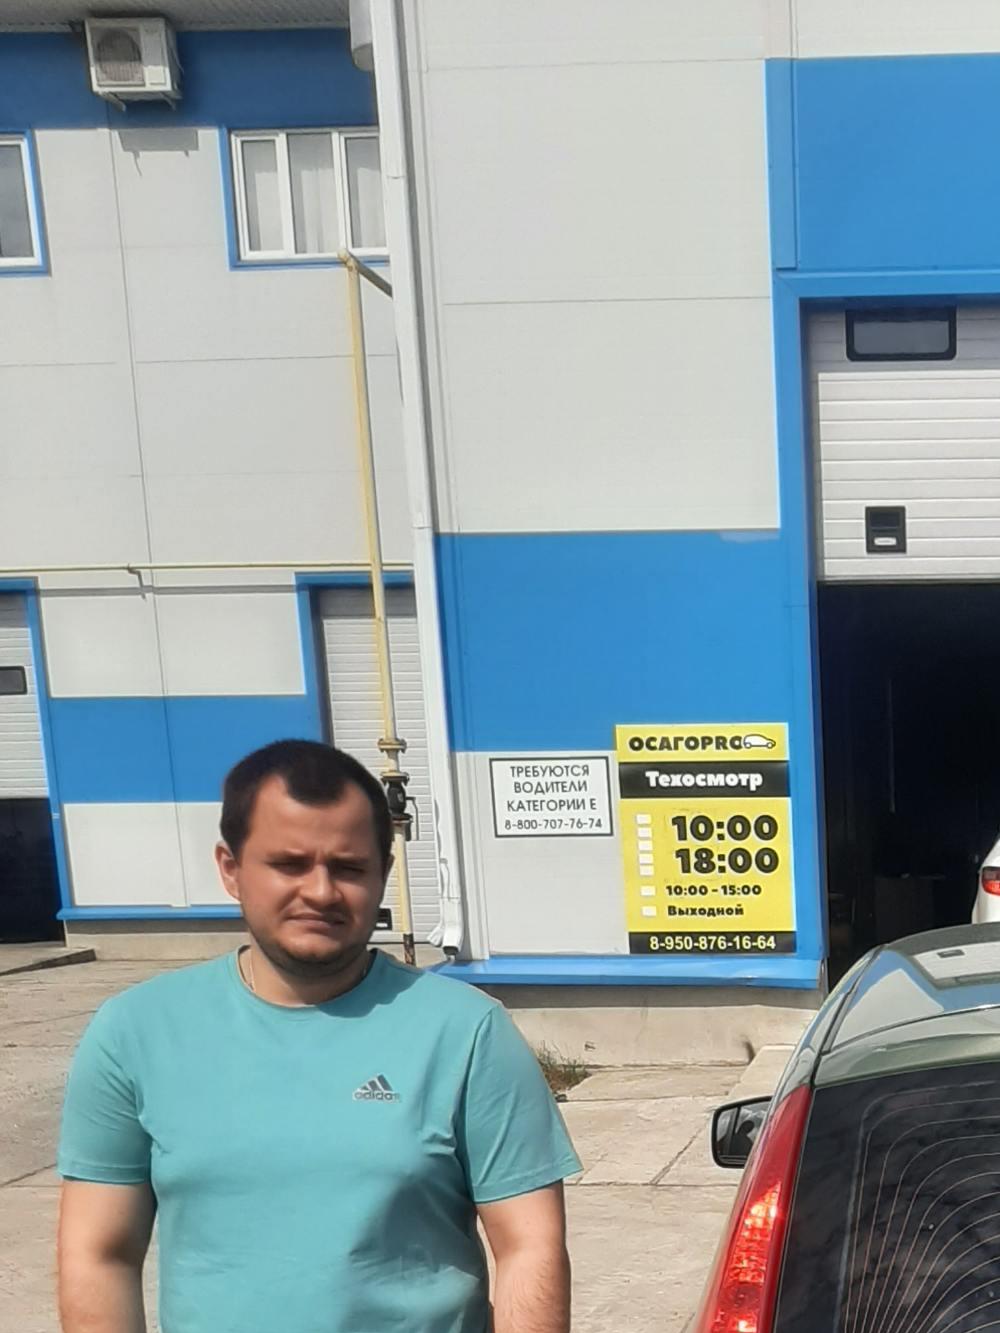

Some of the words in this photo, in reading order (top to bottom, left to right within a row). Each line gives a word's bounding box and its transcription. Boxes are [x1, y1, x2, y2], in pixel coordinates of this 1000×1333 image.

[510, 764, 590, 778] ТРЕБУЮТСЯ
[645, 770, 763, 791] Техосмотр
[513, 780, 588, 796] ВОДИТЕЛИ
[507, 798, 586, 812] КАТЕГОРИИ
[590, 798, 597, 810] Е
[504, 818, 603, 830] 8-800-707-76-74
[671, 815, 779, 842] 10:00
[675, 847, 780, 874] 18:00
[666, 885, 708, 896] 10:00
[721, 885, 762, 896] 15:00
[667, 904, 744, 917] Выходной
[650, 936, 776, 950] 8-950-876-16-64
